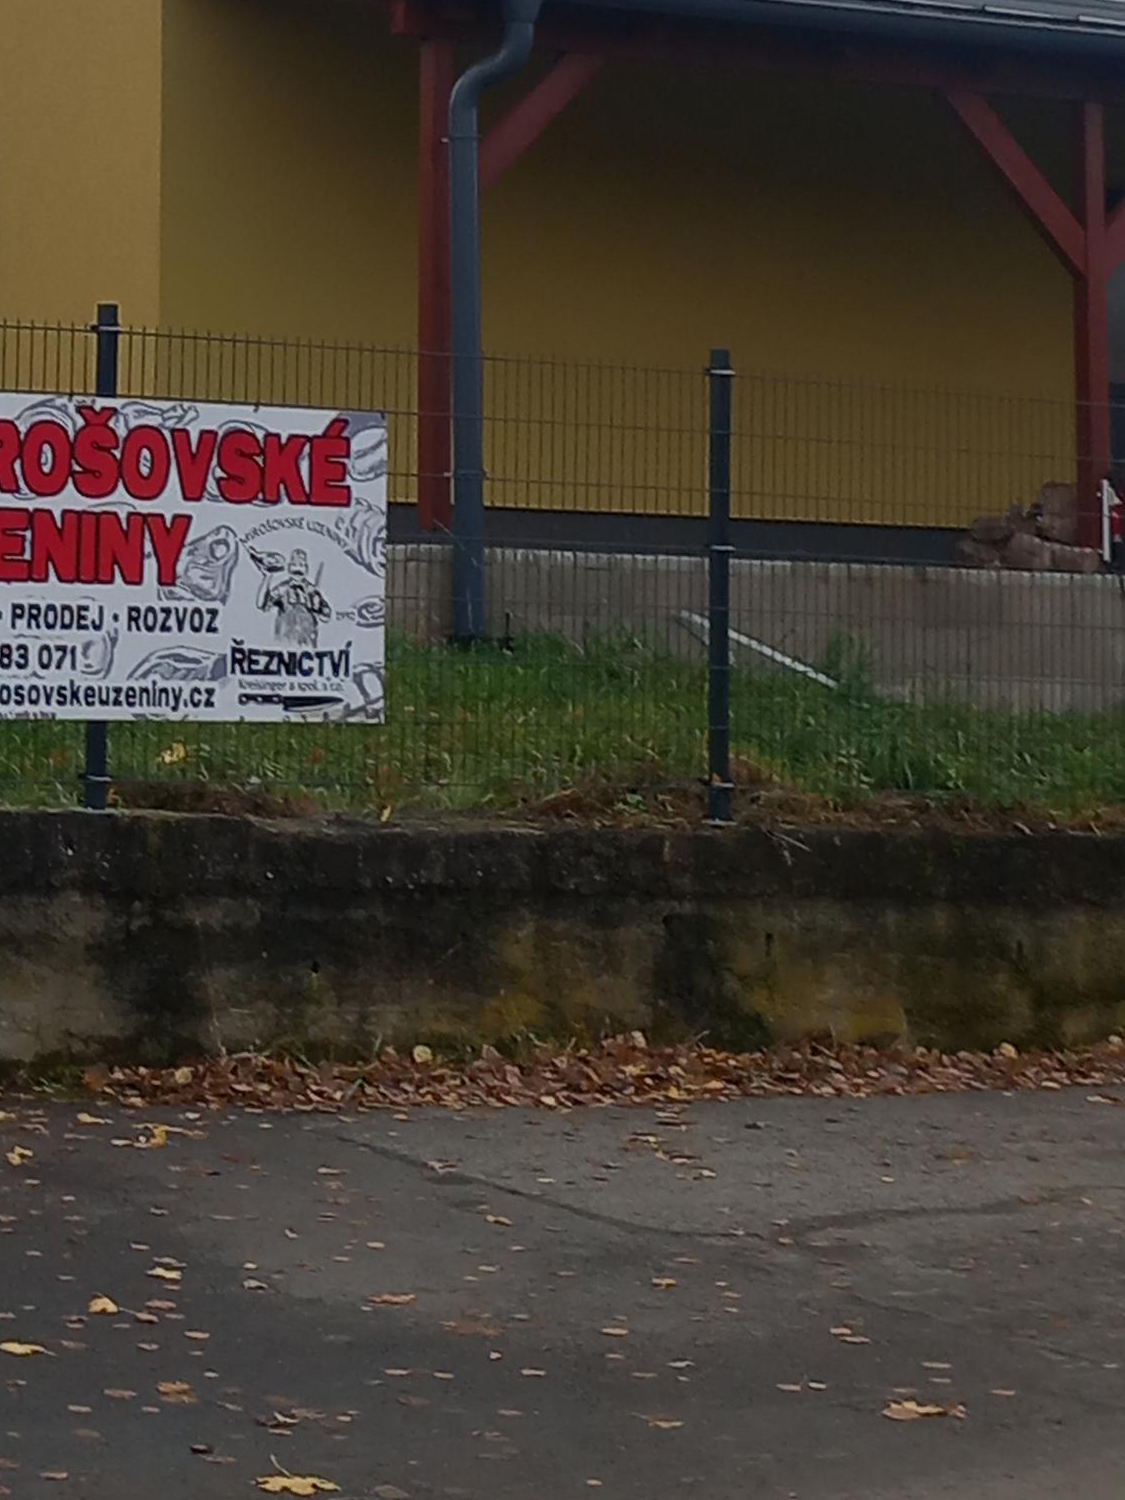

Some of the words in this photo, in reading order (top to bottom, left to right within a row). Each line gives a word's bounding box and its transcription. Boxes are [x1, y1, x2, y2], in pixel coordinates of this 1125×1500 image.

[11, 602, 104, 631] PRODEJ
[127, 606, 219, 633] ROZVOZ
[37, 645, 77, 670] 071
[230, 638, 352, 677] ŘEZNICTVÍ
